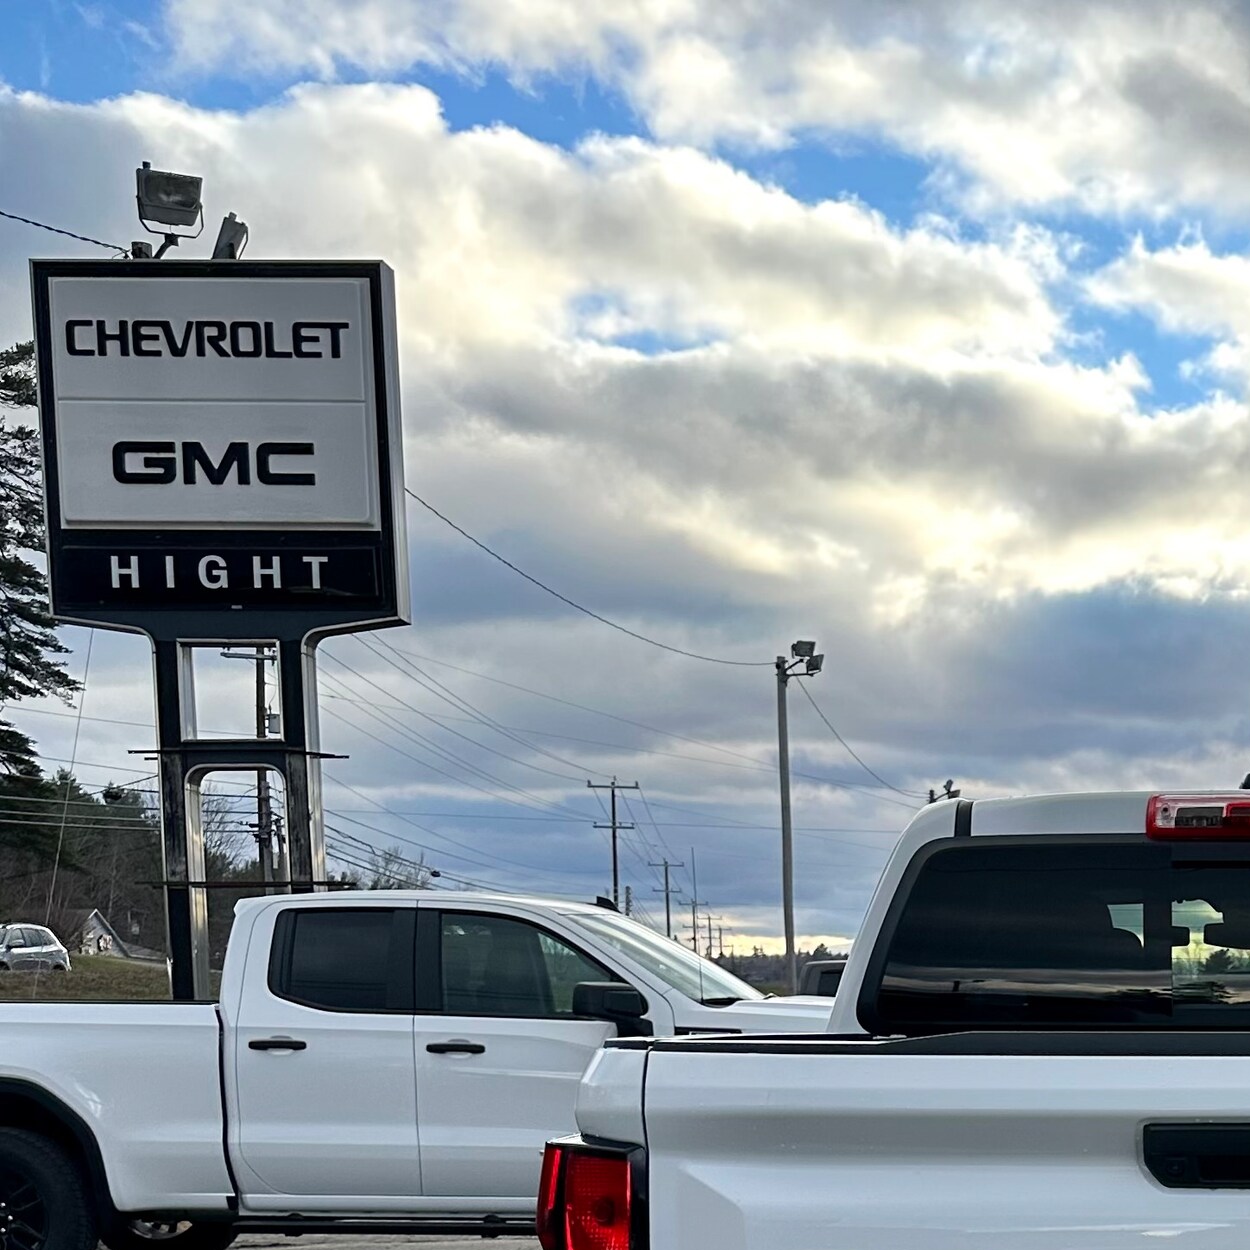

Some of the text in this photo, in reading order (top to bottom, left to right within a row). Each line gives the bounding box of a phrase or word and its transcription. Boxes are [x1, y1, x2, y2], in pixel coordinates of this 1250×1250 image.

[65, 319, 350, 359] CHEVROLET
[112, 441, 316, 486] GMC
[110, 555, 329, 589] HIGHT
